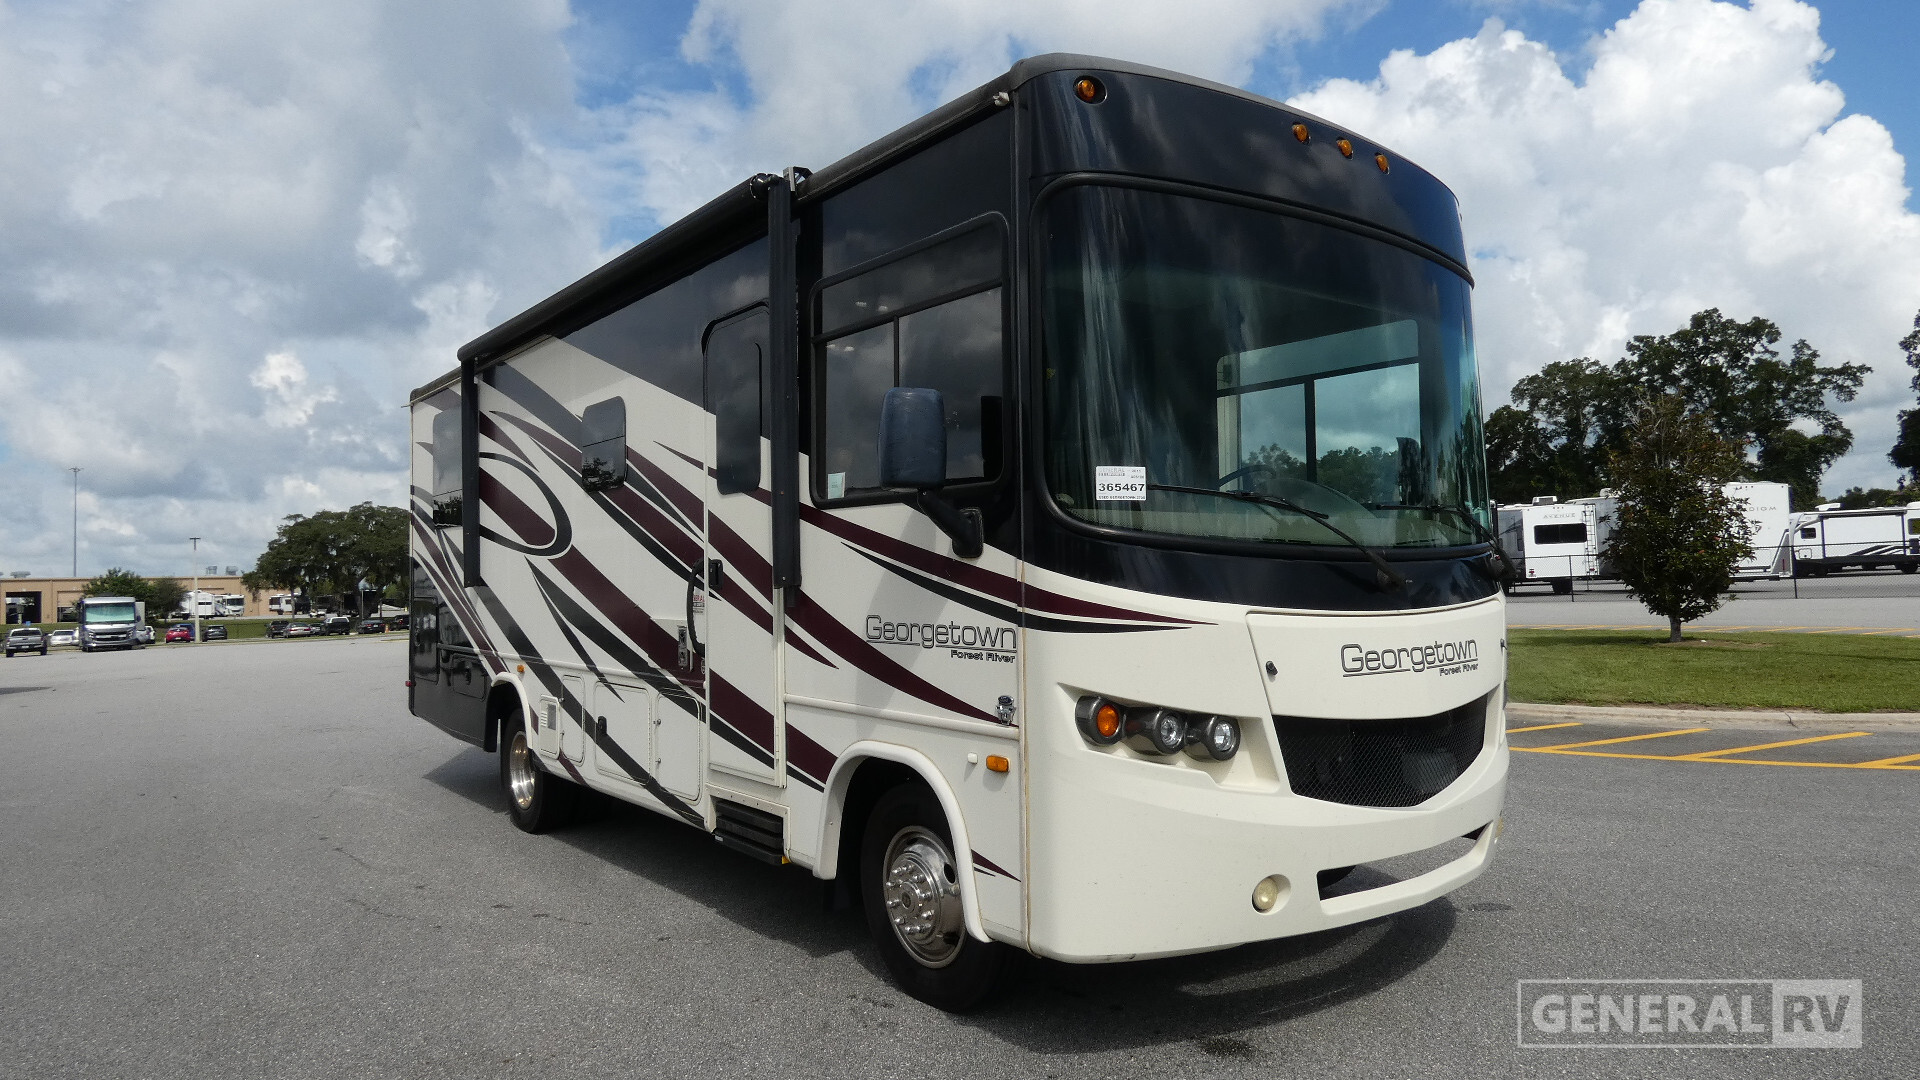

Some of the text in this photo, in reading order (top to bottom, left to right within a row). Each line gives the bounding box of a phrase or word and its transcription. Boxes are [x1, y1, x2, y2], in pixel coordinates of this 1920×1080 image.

[1098, 483, 1145, 492] 365467
[866, 615, 1017, 649] Georgetown
[950, 650, 1016, 663] Forest River
[1340, 639, 1478, 672] Georgetown
[1439, 663, 1479, 677] Forest River
